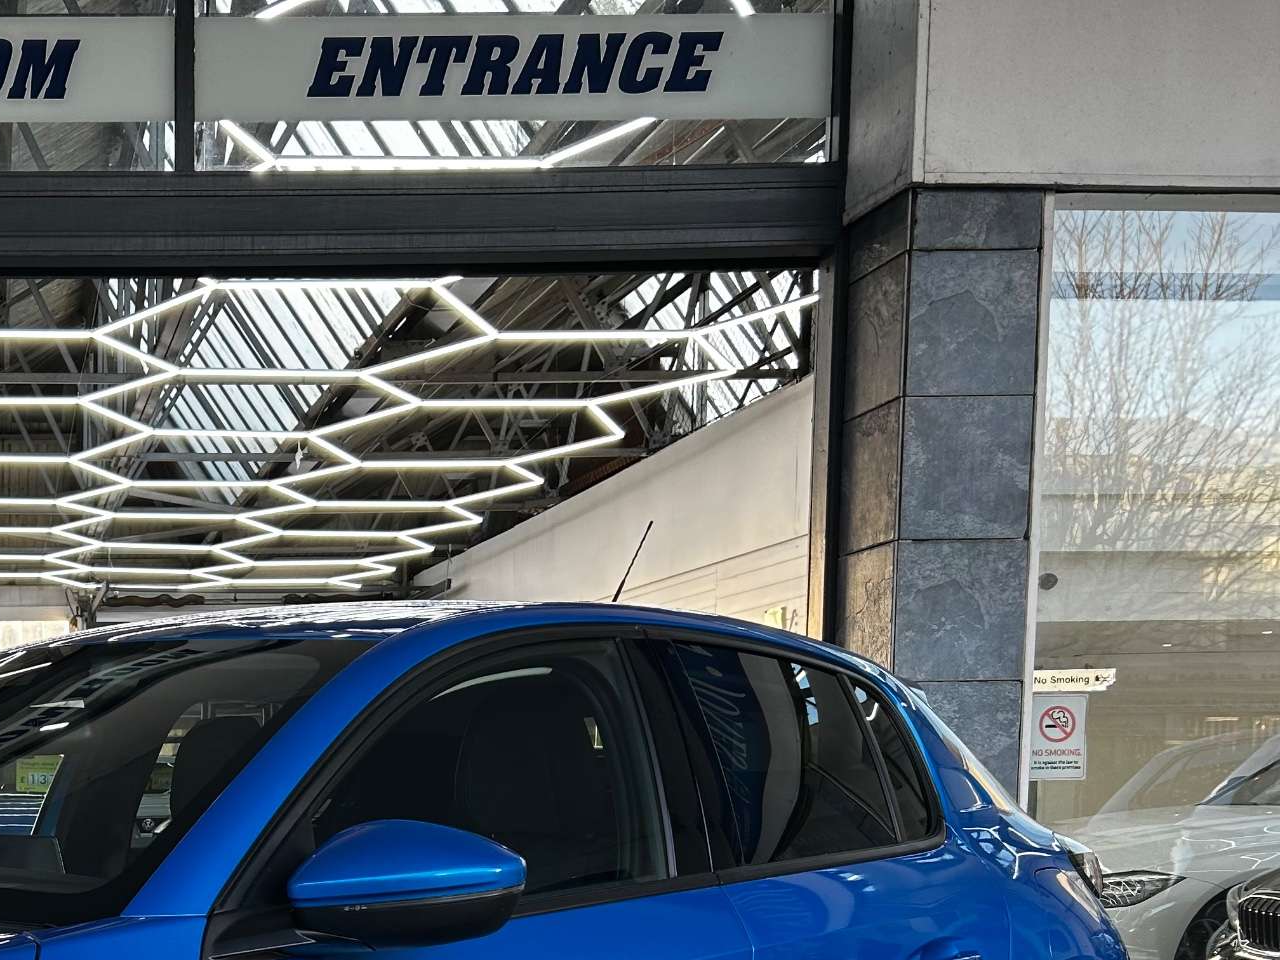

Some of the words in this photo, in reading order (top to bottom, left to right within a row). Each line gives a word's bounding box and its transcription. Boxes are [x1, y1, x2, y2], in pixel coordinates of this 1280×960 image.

[306, 31, 724, 98] ENTRANCE
[1033, 676, 1047, 685] No
[1050, 675, 1090, 685] Smoking
[1032, 749, 1043, 757] NO
